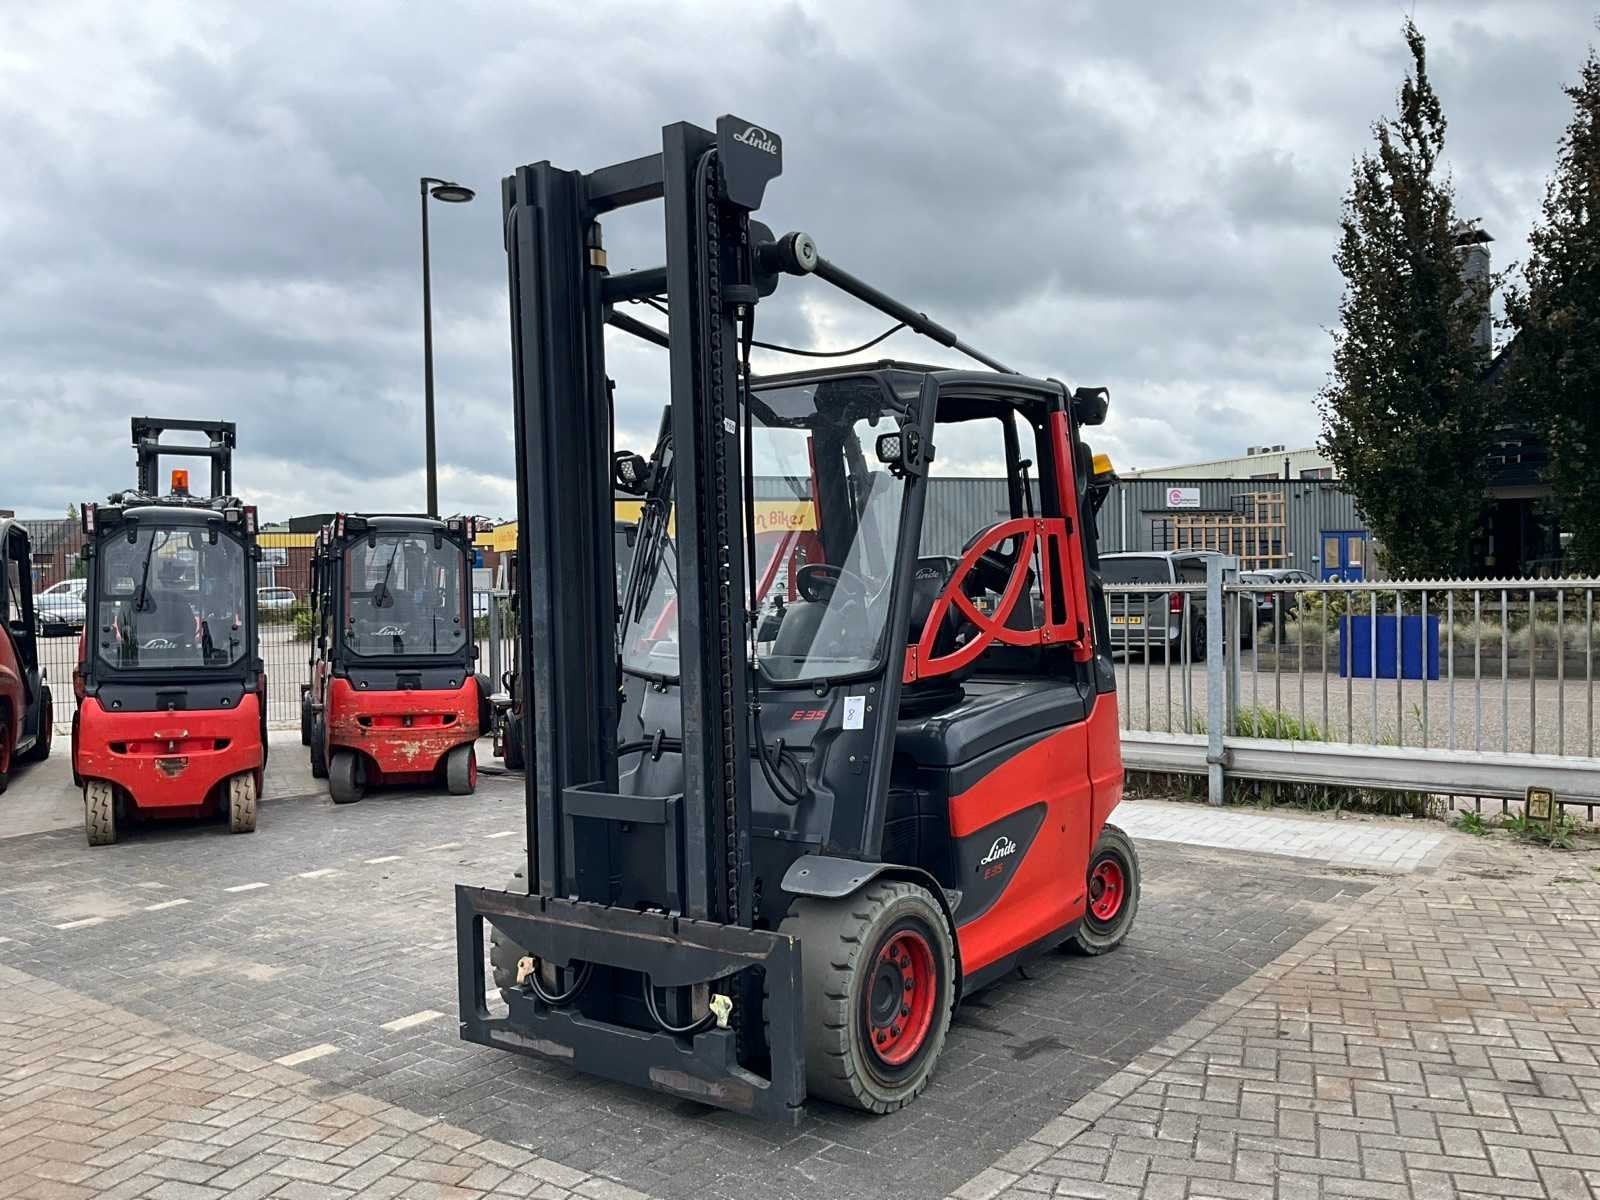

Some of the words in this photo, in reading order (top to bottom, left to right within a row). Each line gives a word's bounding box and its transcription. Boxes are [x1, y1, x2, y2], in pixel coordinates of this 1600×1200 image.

[733, 126, 777, 155] Linde
[769, 510, 806, 529] Bikes
[370, 625, 406, 637] Linde
[139, 638, 177, 649] Linde
[980, 836, 1017, 865] Linde
